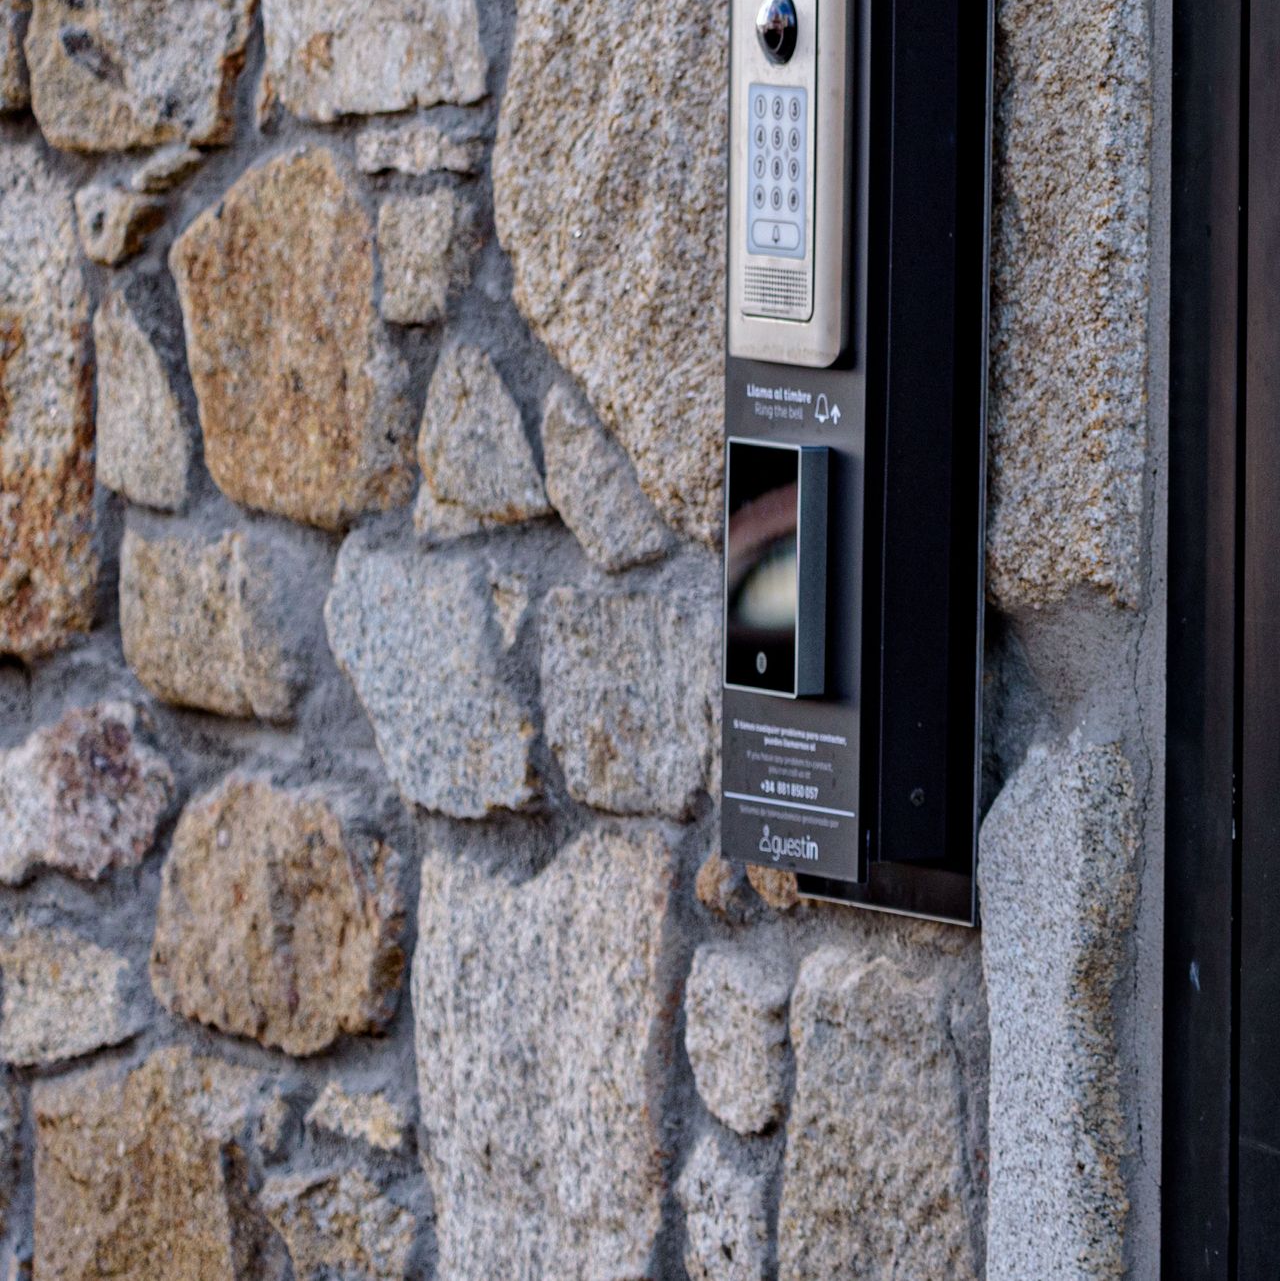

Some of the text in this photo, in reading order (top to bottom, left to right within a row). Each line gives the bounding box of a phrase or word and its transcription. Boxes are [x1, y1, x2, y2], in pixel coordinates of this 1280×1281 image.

[747, 383, 811, 404] Llama al timbre
[754, 401, 773, 420] Ring
[771, 834, 819, 861] guestin
